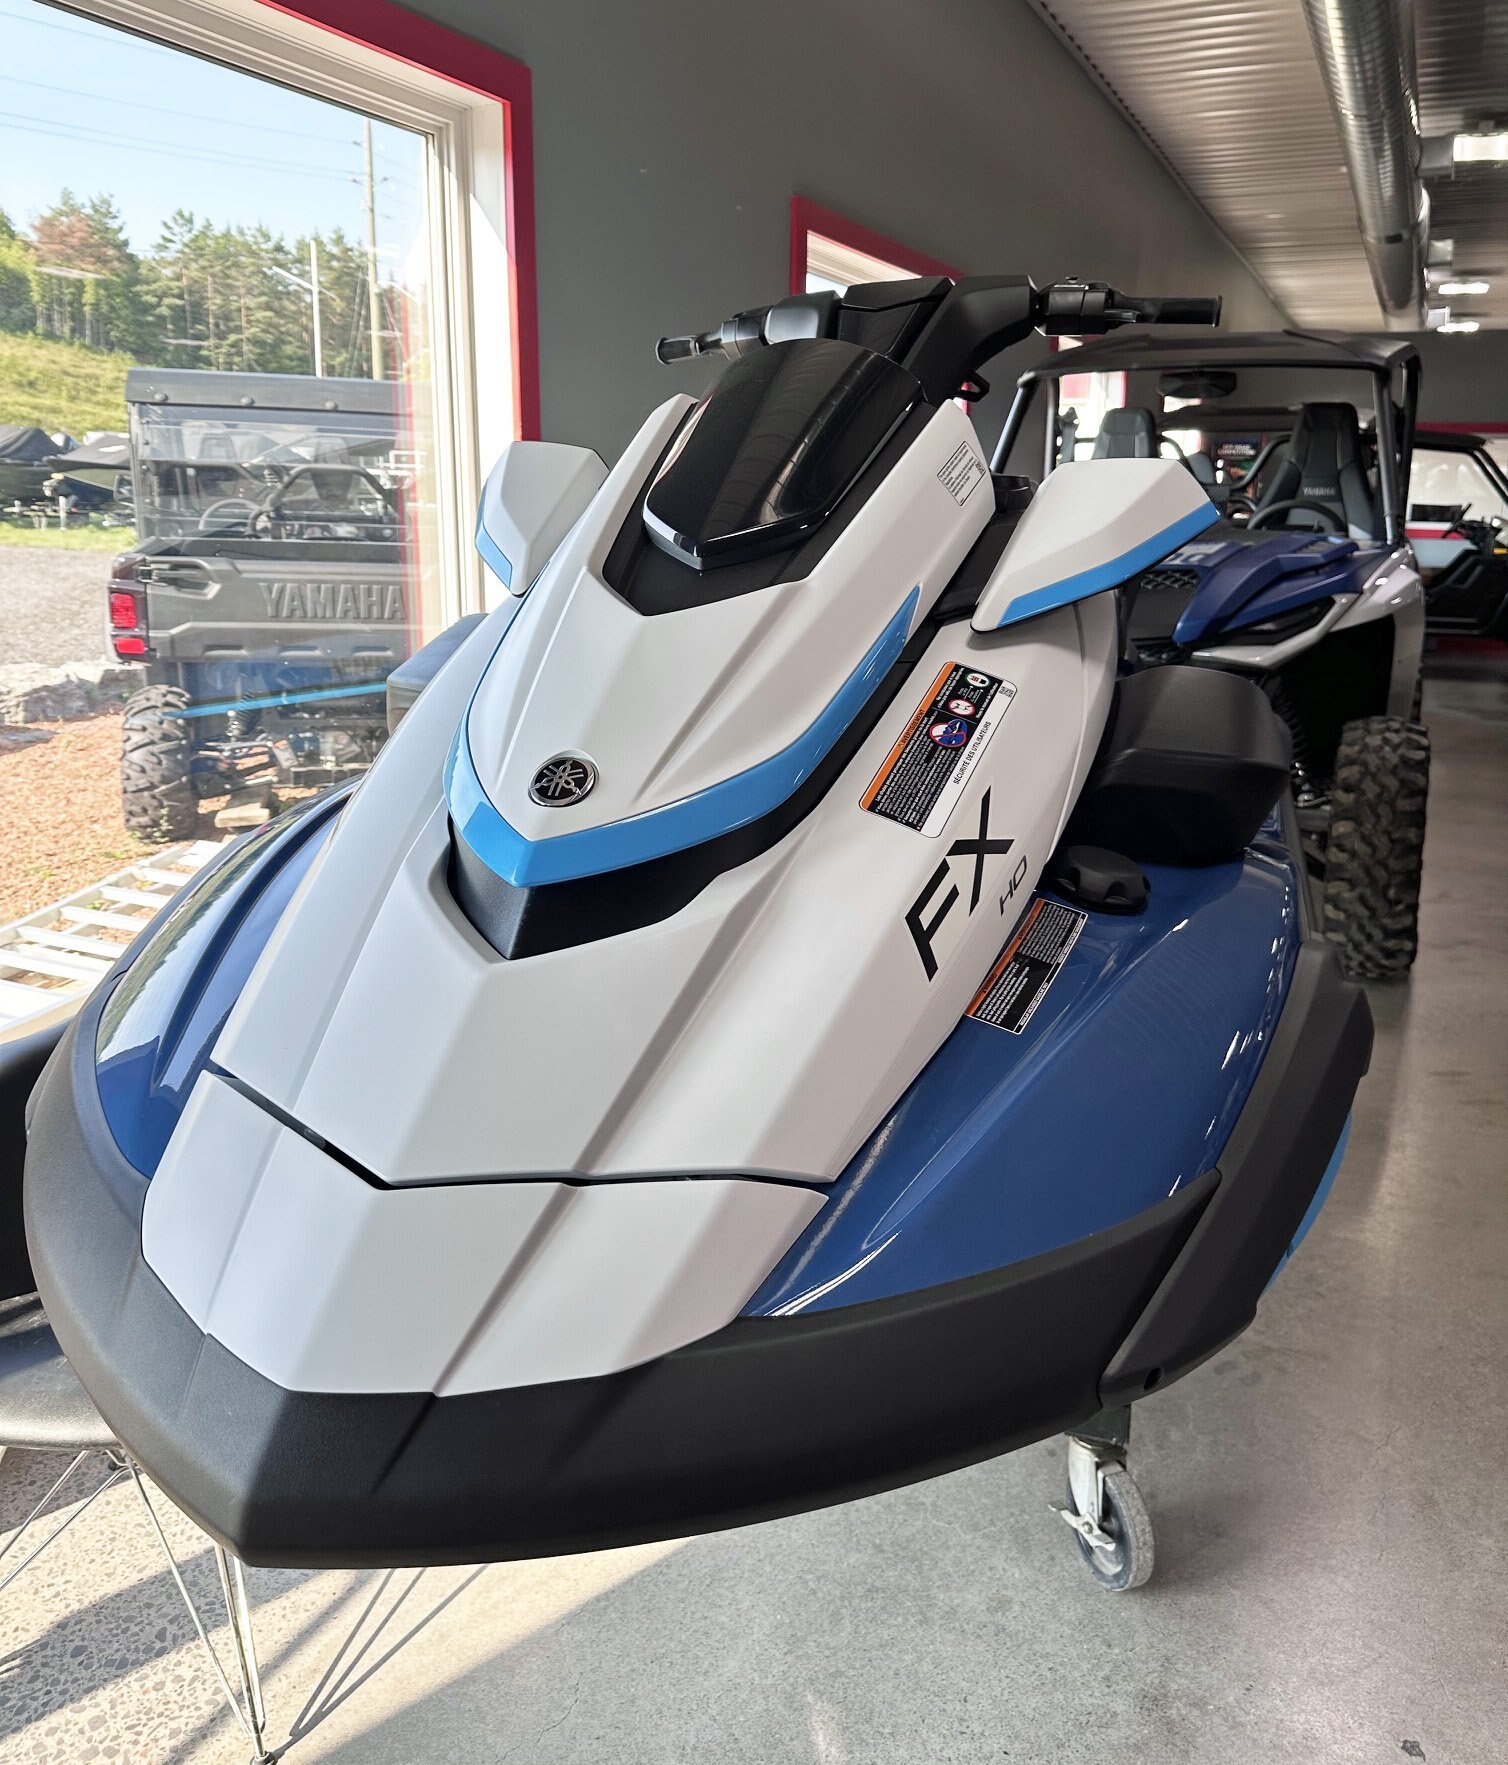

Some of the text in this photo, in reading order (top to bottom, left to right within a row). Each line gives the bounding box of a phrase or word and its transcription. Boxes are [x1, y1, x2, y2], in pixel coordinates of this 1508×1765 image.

[259, 582, 408, 619] YAMAHA
[965, 751, 975, 761] DES
[971, 721, 991, 751] UTILISATEURS
[905, 785, 1015, 982] FX
[999, 854, 1028, 916] HO
